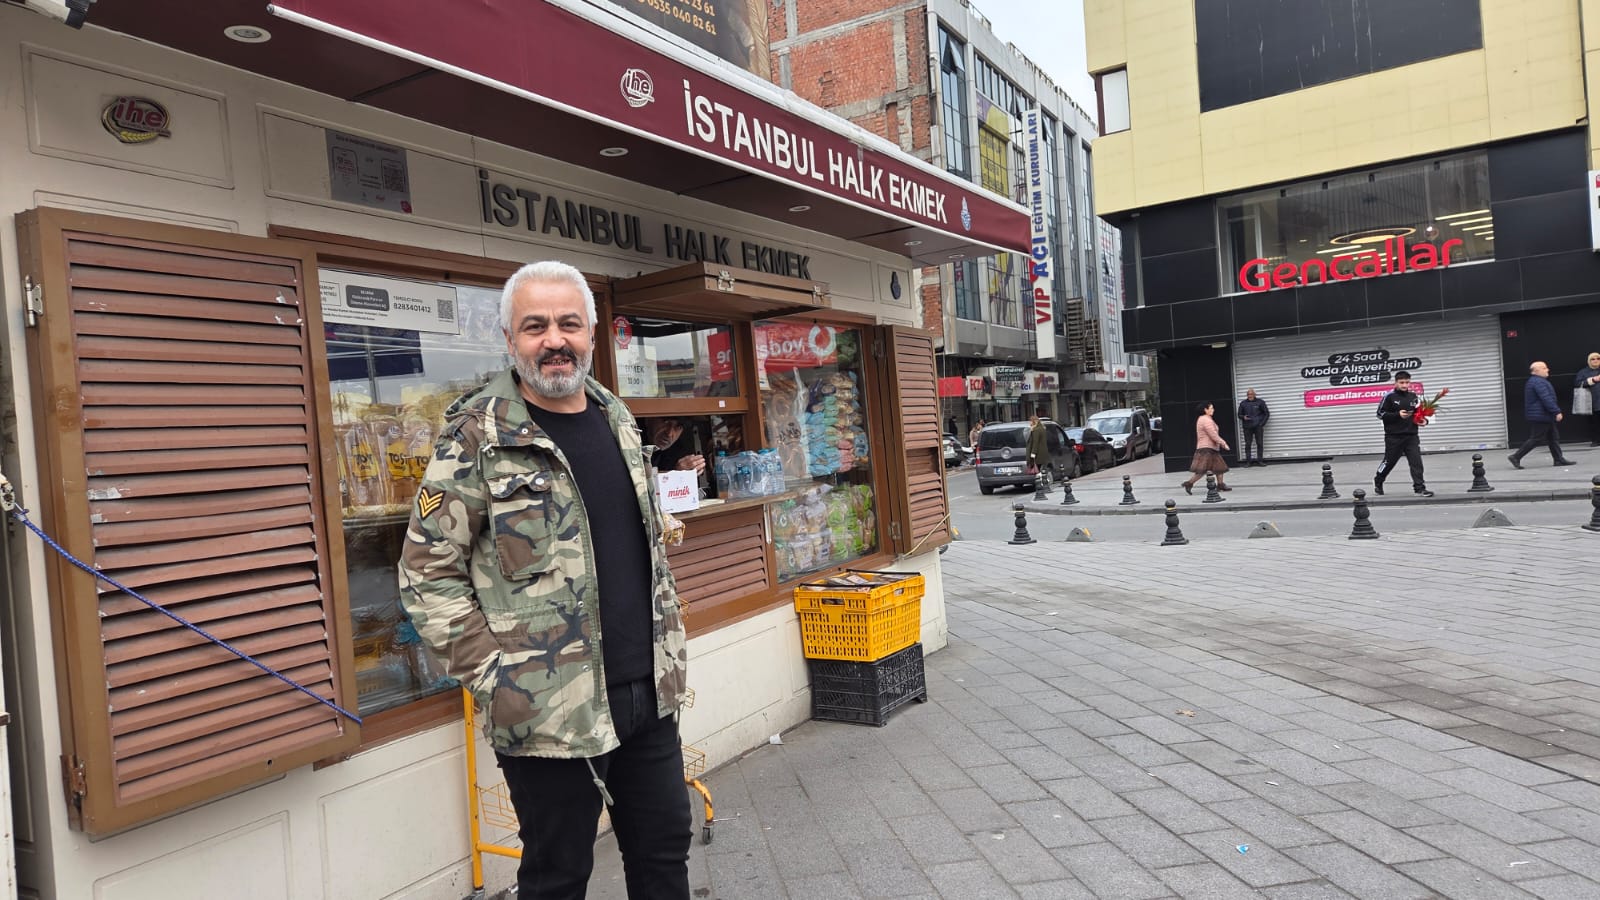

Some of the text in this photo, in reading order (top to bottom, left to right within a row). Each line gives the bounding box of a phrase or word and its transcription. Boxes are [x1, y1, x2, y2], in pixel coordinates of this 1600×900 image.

[673, 6, 691, 23] 040
[692, 15, 704, 30] 82
[705, 21, 717, 35] 61
[704, 2, 715, 17] 61
[625, 68, 651, 95] ihe
[116, 97, 163, 128] ihe
[683, 79, 948, 224] İSTANBUL HALK EKMEK
[478, 169, 812, 280] İSTANBUL HALK EKMEK
[1028, 112, 1051, 325] VIP AÇI EĞİTİM KURUMLARI
[1304, 358, 1418, 377] Moda Alışverişinin
[1334, 351, 1383, 364] 24 Saat
[1340, 372, 1381, 385] Adresi
[667, 485, 690, 498] minik
